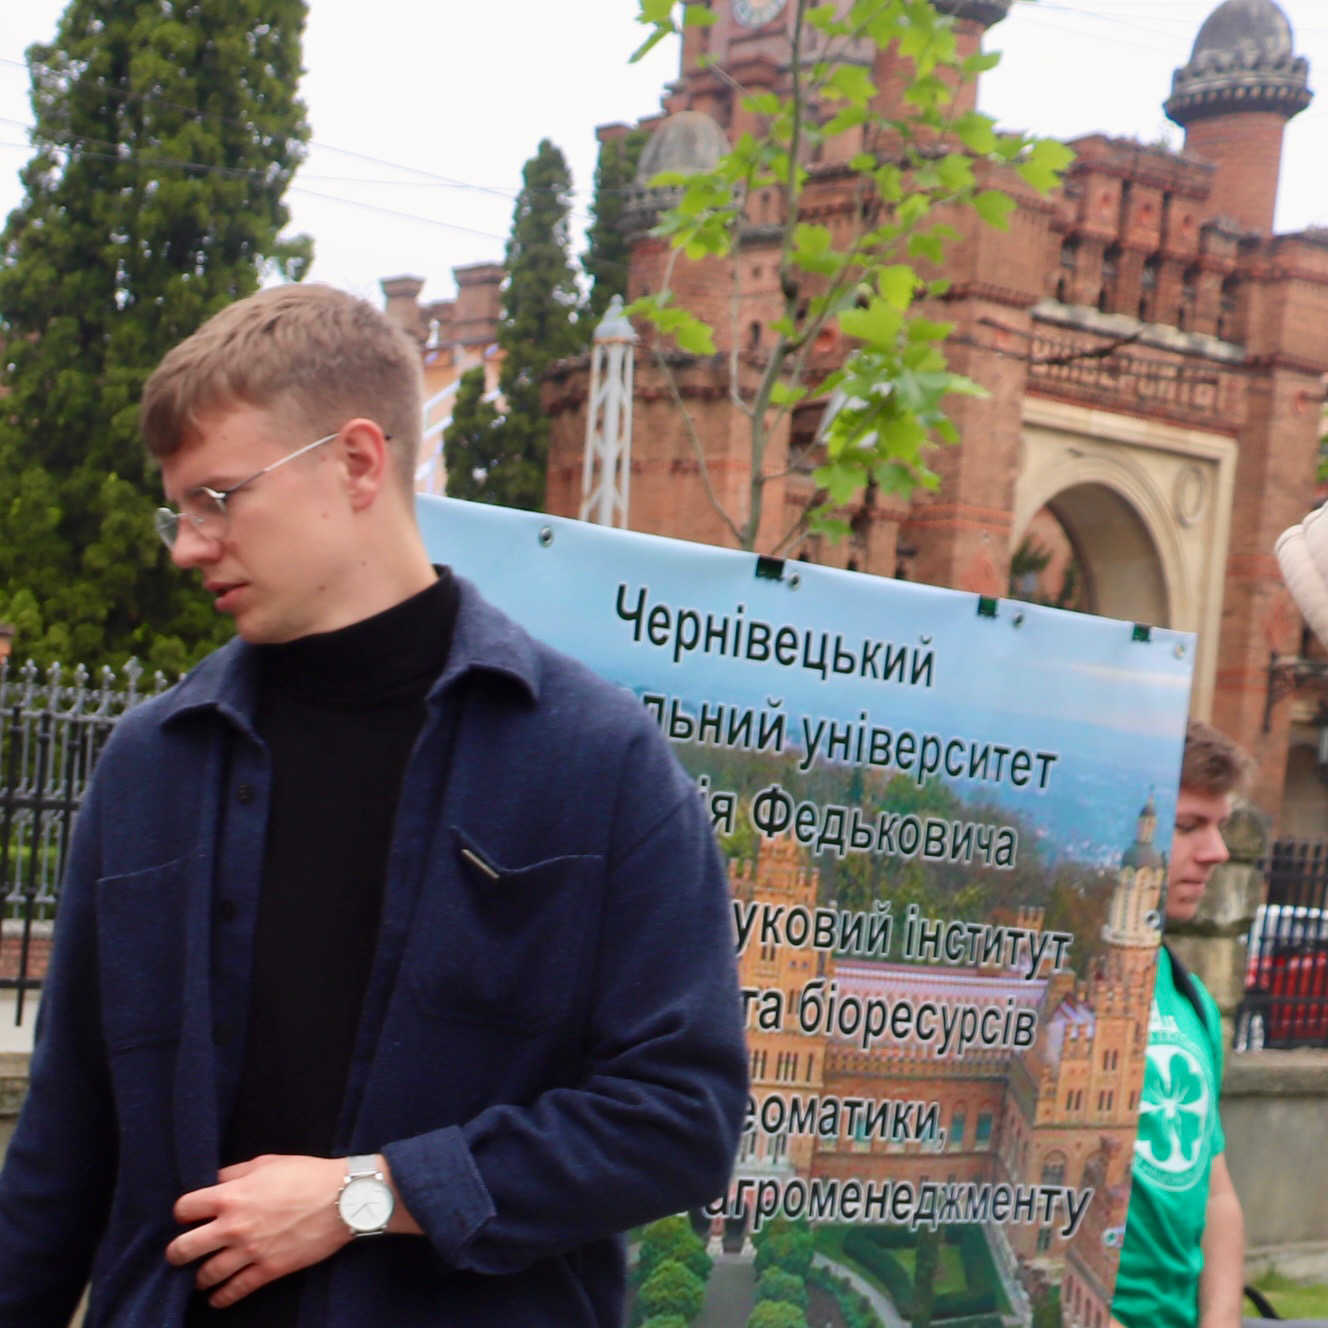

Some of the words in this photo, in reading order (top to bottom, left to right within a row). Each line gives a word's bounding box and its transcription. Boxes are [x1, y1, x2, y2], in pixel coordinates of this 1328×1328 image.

[613, 582, 937, 688] Чернівецький
[800, 712, 1059, 791] університет
[753, 783, 1018, 869] Федьковича
[905, 910, 1074, 981] інститут
[797, 979, 1038, 1056] біоресурсів
